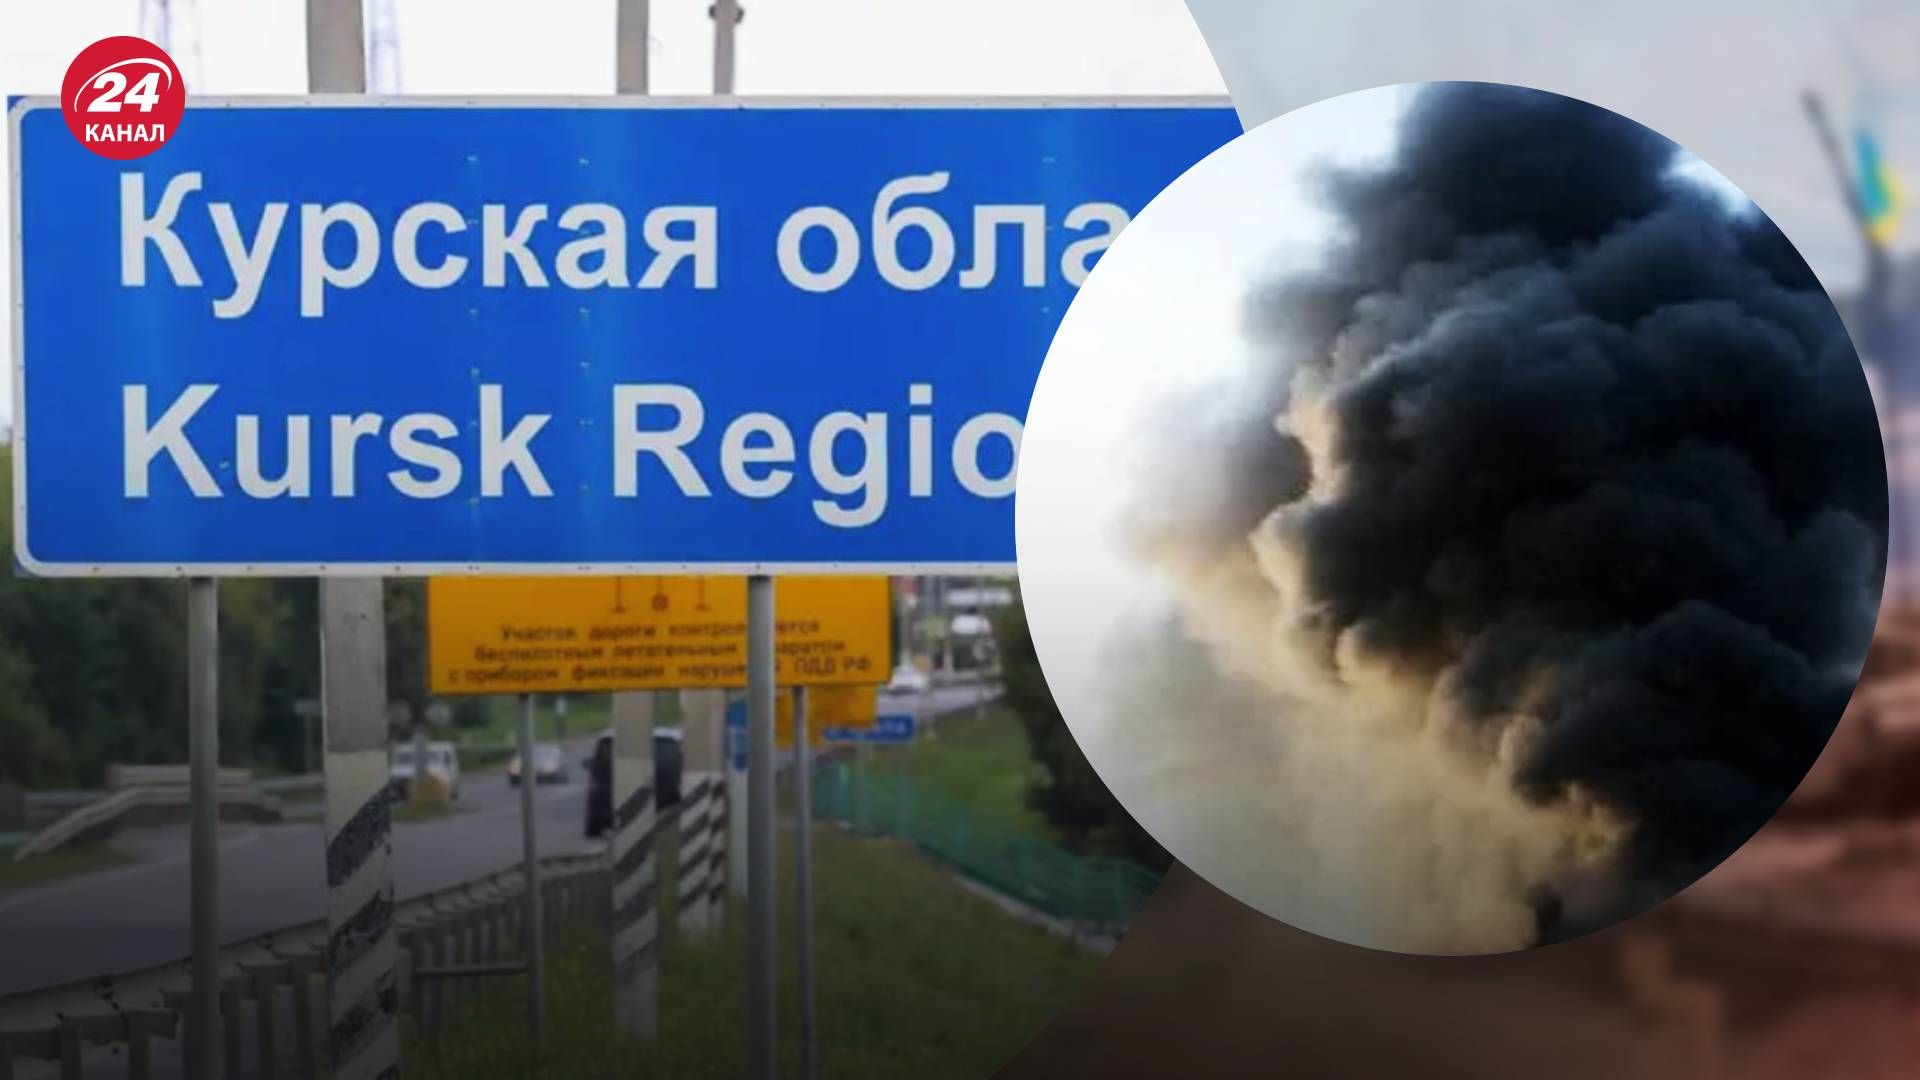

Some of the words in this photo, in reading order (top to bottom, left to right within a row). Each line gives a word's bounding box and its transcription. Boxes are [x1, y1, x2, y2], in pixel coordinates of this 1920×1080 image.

[119, 171, 719, 318] Курская
[122, 384, 554, 499] Kursk
[613, 384, 1026, 528] Regio
[501, 625, 577, 641] Участок
[589, 625, 655, 641] дороги
[668, 621, 820, 638] контролется
[474, 644, 603, 662] беспилотным
[613, 643, 737, 658] летательным
[465, 665, 559, 684] прибором
[572, 665, 665, 682] фиксации
[794, 656, 837, 676] ПДД
[842, 656, 873, 673] РФ
